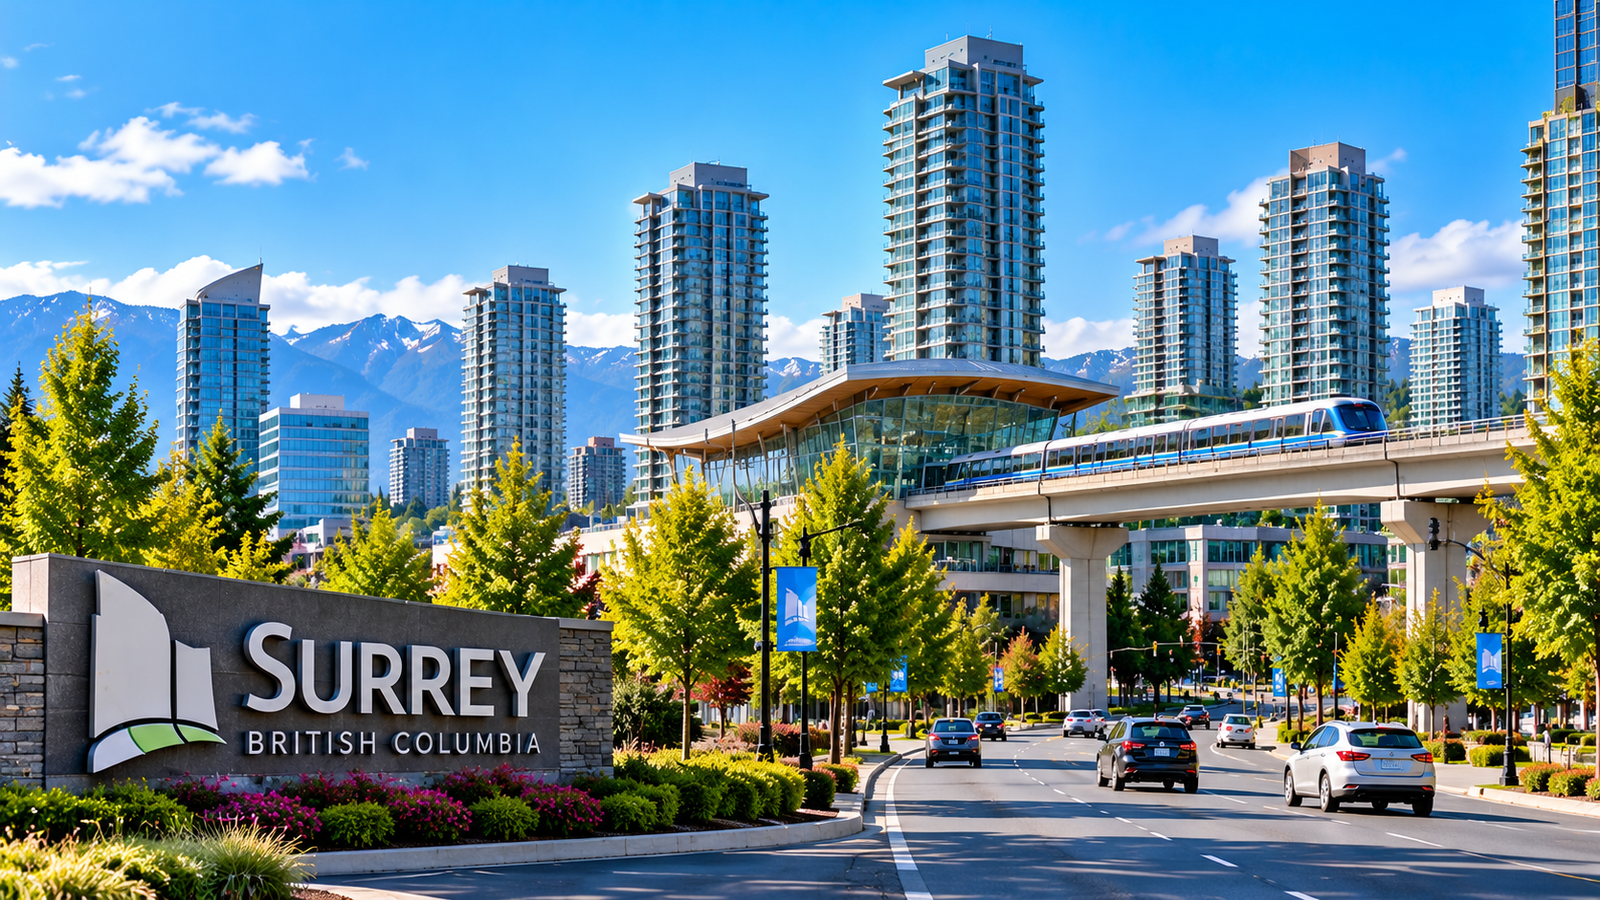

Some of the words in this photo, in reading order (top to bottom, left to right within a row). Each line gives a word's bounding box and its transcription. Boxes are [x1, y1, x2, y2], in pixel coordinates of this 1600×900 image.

[244, 621, 547, 718] SURREY
[247, 730, 376, 755] BRITISH
[392, 731, 541, 755] COLUMBIA
